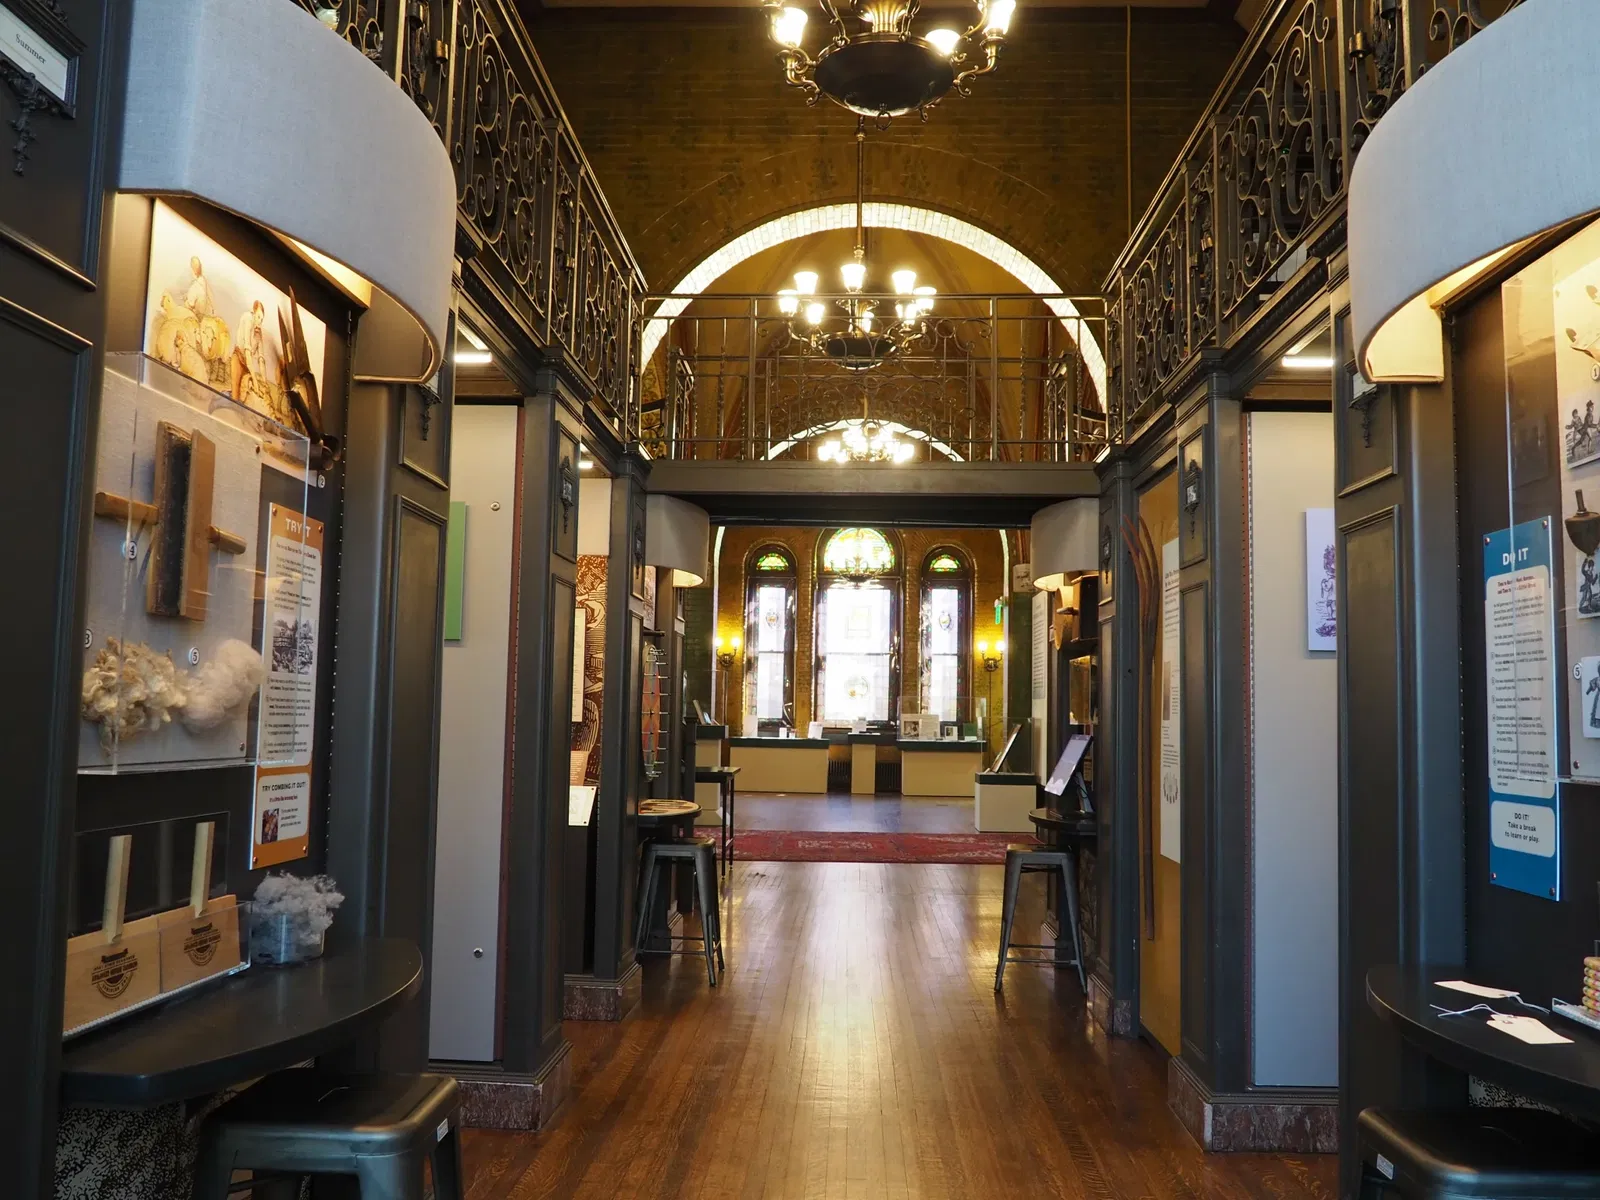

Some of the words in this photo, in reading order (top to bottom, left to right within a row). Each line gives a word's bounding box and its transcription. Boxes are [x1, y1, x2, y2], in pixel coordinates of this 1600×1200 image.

[15, 33, 46, 64] Summer
[285, 517, 302, 534] TRY
[130, 545, 135, 557] 4
[1502, 551, 1516, 566] DO
[1518, 547, 1529, 562] IT
[191, 651, 198, 662] 5
[1574, 666, 1580, 677] 5
[1514, 812, 1522, 820] DO
[1507, 821, 1519, 829] Take
[1523, 823, 1537, 832] break
[1510, 831, 1522, 839] learn
